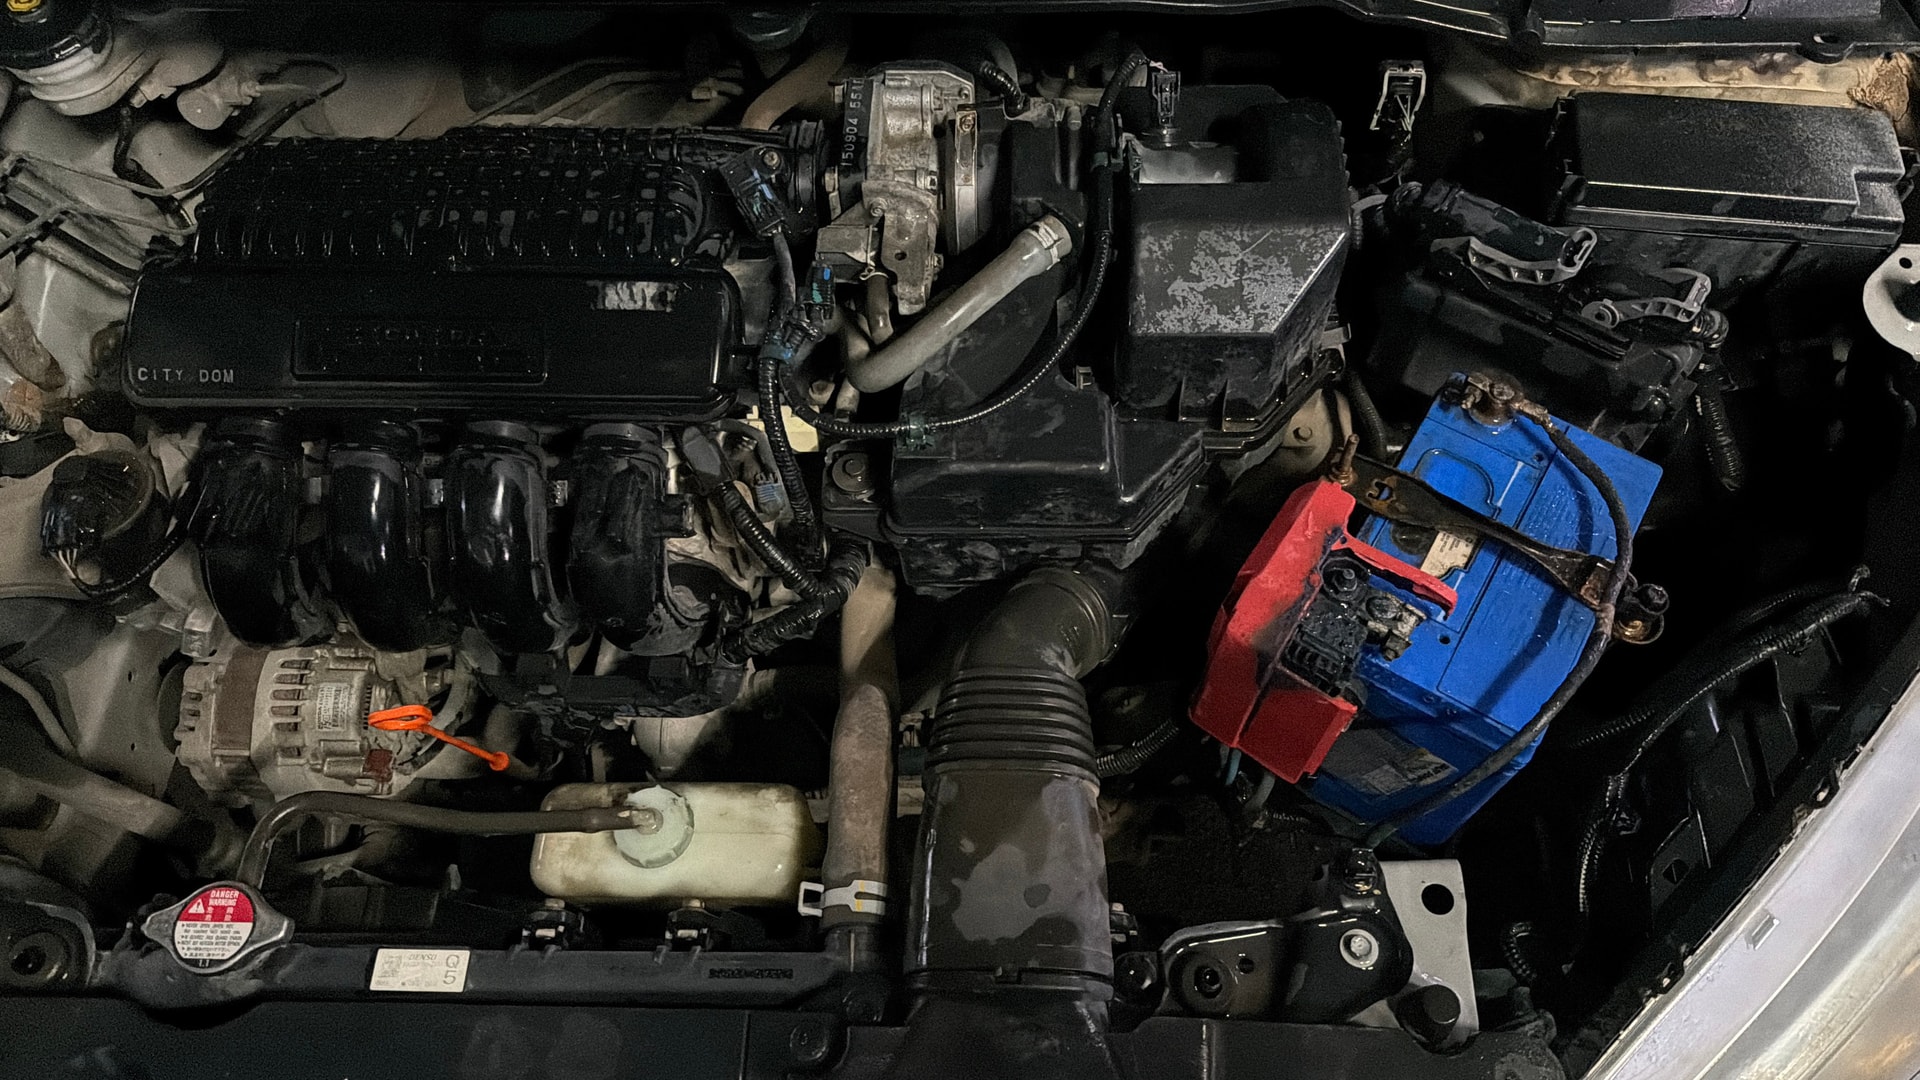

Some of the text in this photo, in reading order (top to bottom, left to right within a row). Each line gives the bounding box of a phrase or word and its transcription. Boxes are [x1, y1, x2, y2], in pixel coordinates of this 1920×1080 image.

[840, 118, 858, 166] 150904
[137, 367, 234, 383] CITY DOM
[210, 890, 239, 898] DANGER
[208, 898, 237, 906] WARNING
[445, 954, 460, 969] Q
[443, 970, 456, 985] 5
